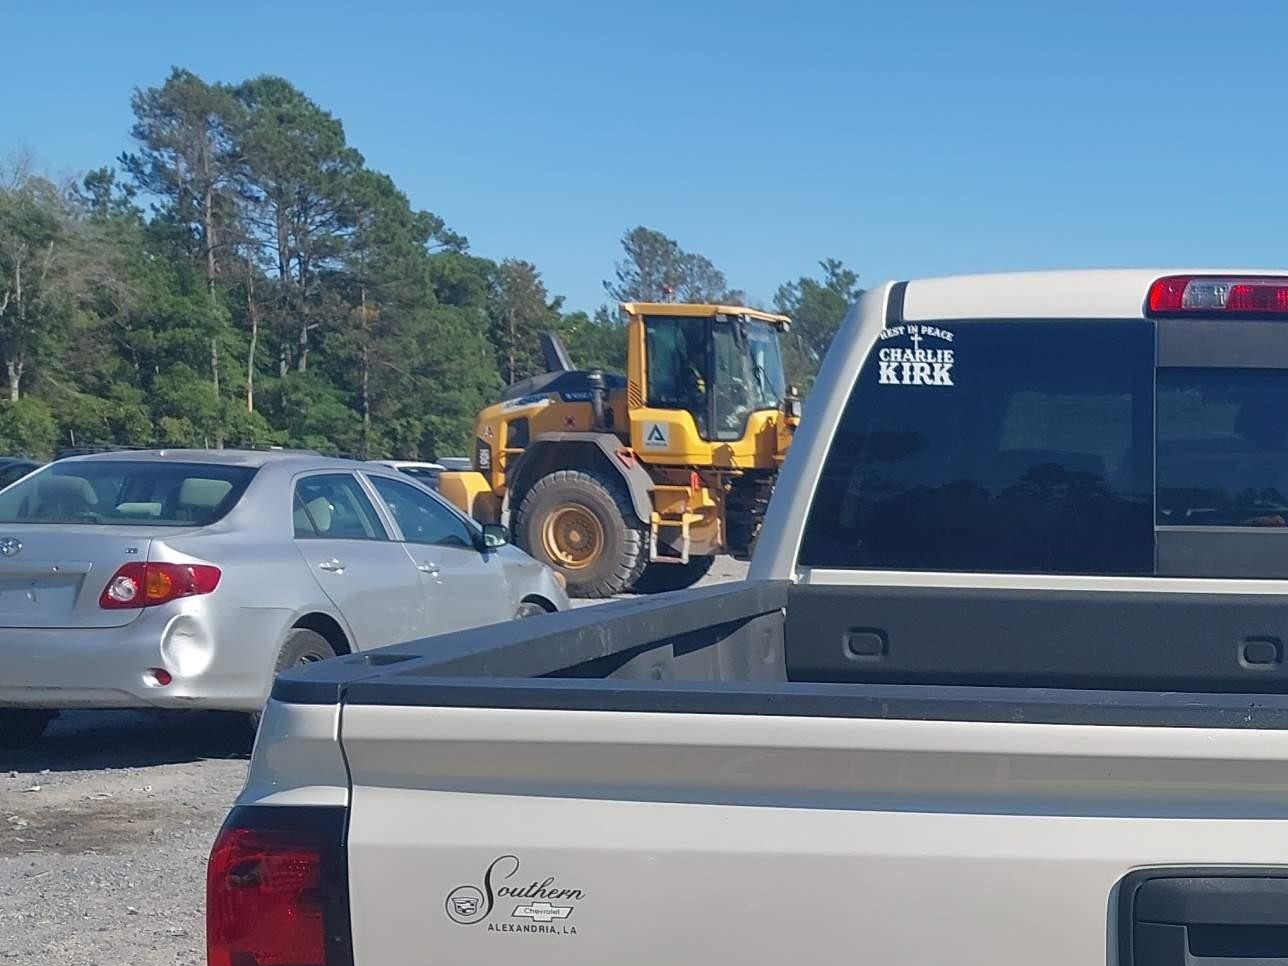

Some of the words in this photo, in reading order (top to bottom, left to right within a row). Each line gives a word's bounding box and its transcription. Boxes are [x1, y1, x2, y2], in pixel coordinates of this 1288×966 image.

[880, 326, 905, 340] REST
[907, 324, 918, 334] IN
[921, 325, 954, 342] PEACE
[879, 348, 954, 363] CHARLIE
[879, 362, 954, 386] KIRK
[523, 907, 560, 916] Chevrolet
[488, 923, 560, 935] ALEXANDRIA,
[563, 926, 577, 935] LA
